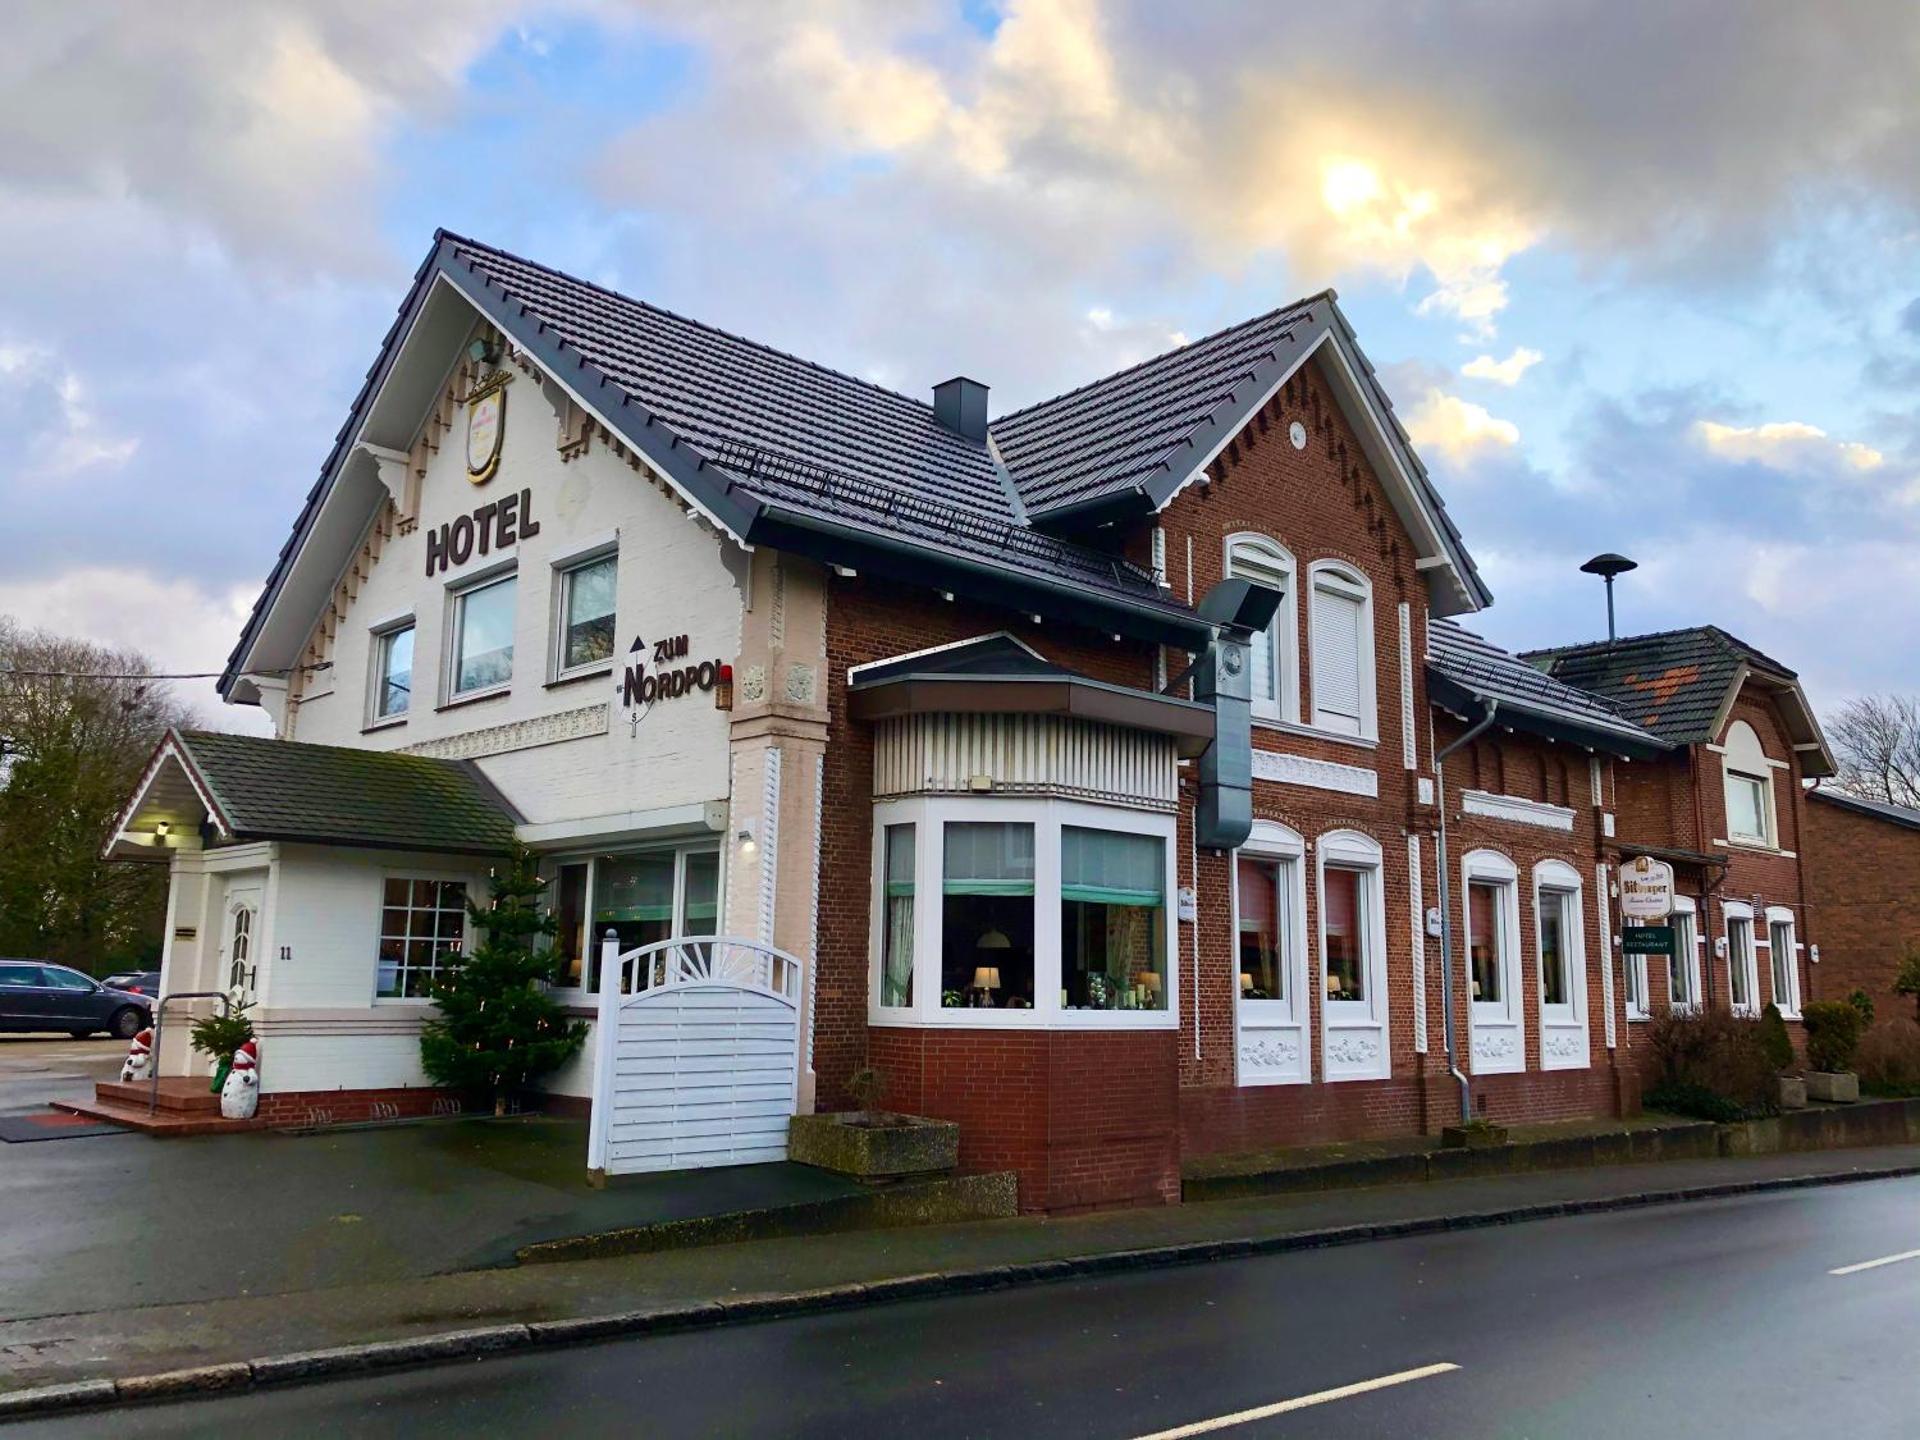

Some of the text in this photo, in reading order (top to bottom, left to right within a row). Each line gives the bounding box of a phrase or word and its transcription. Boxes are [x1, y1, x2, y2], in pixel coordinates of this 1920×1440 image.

[426, 488, 540, 577] HOTEL
[653, 634, 689, 663] ZUM
[280, 946, 291, 960] 11
